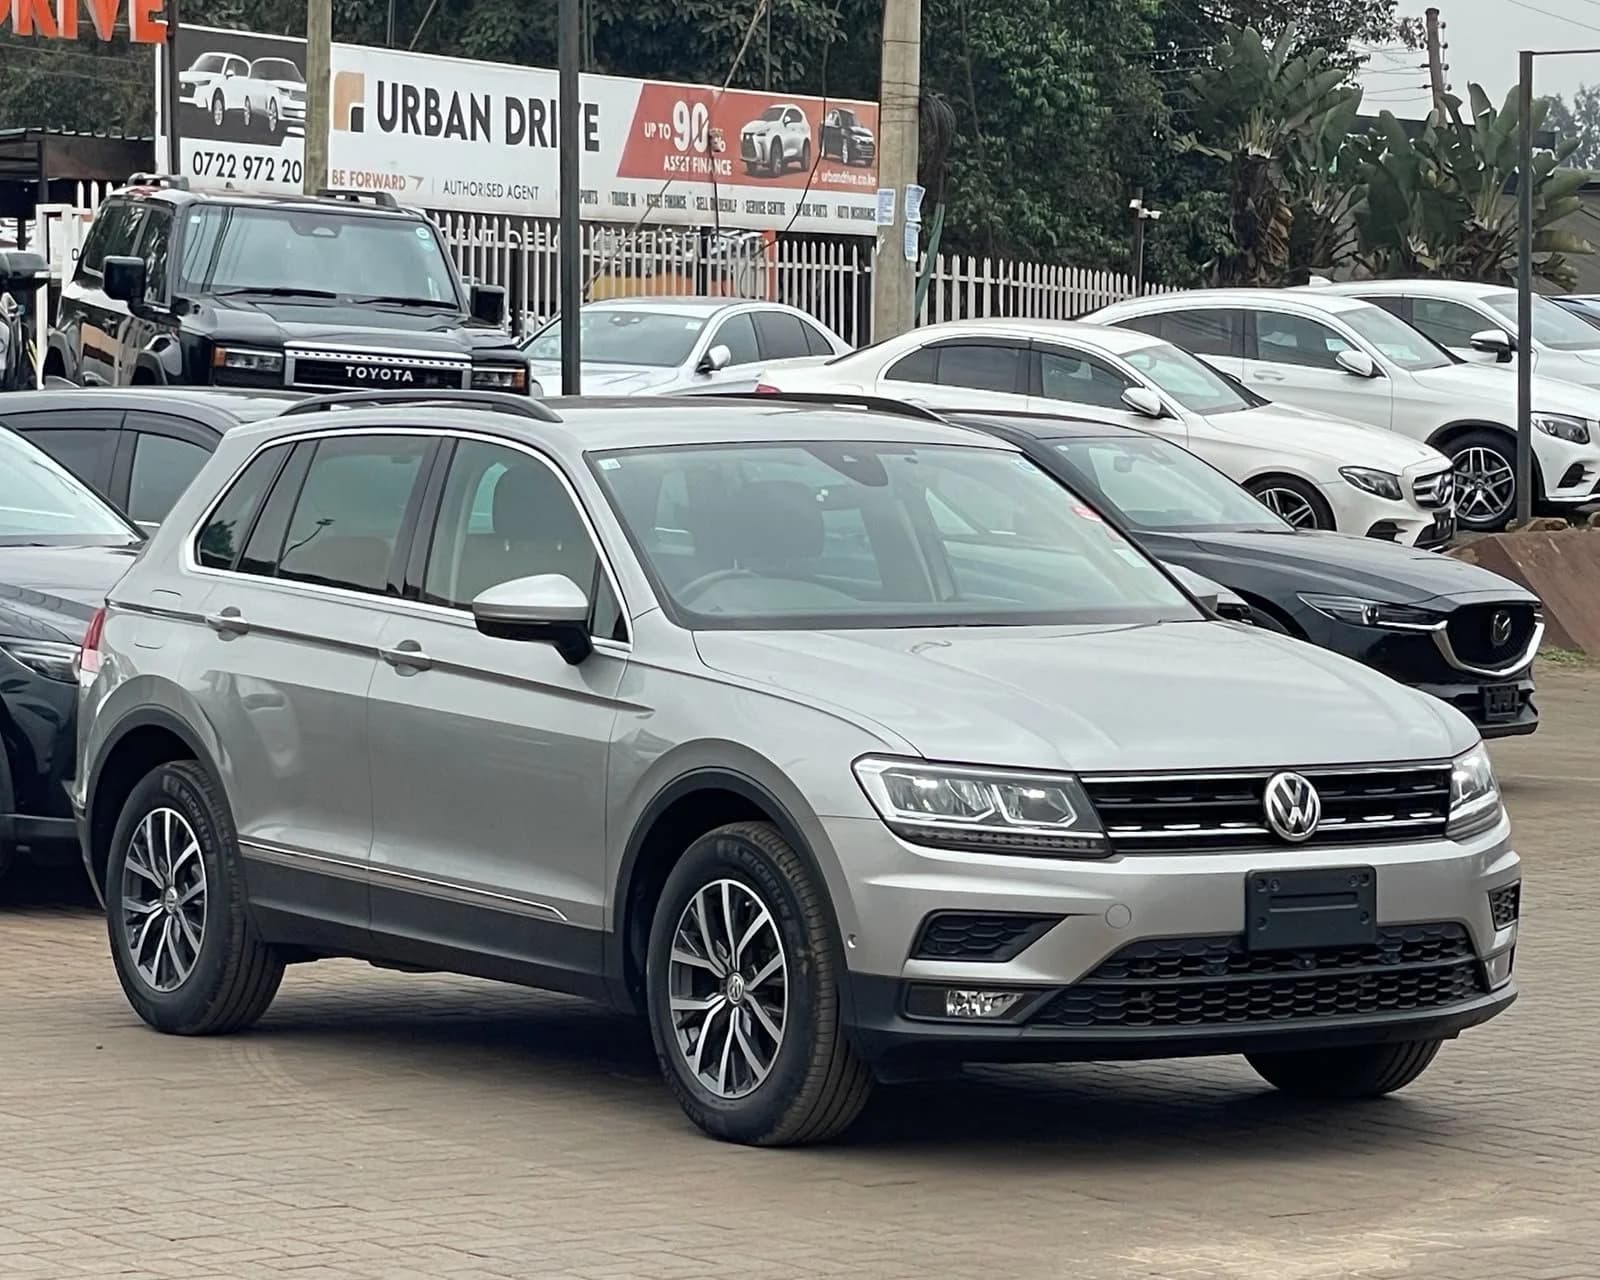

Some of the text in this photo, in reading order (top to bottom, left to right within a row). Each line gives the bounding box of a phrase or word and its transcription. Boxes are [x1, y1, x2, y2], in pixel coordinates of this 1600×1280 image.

[0, 0, 166, 43] RIVE
[377, 80, 600, 152] URBAN DRIE
[644, 122, 656, 138] UP
[658, 123, 671, 139] TO
[193, 151, 302, 184] 0722 972 20
[664, 155, 732, 176] ASSET FINANCE
[332, 169, 406, 191] BE FORWARD
[443, 180, 539, 200] AUTHORISED AGENT
[345, 366, 414, 383] TOYOTA
